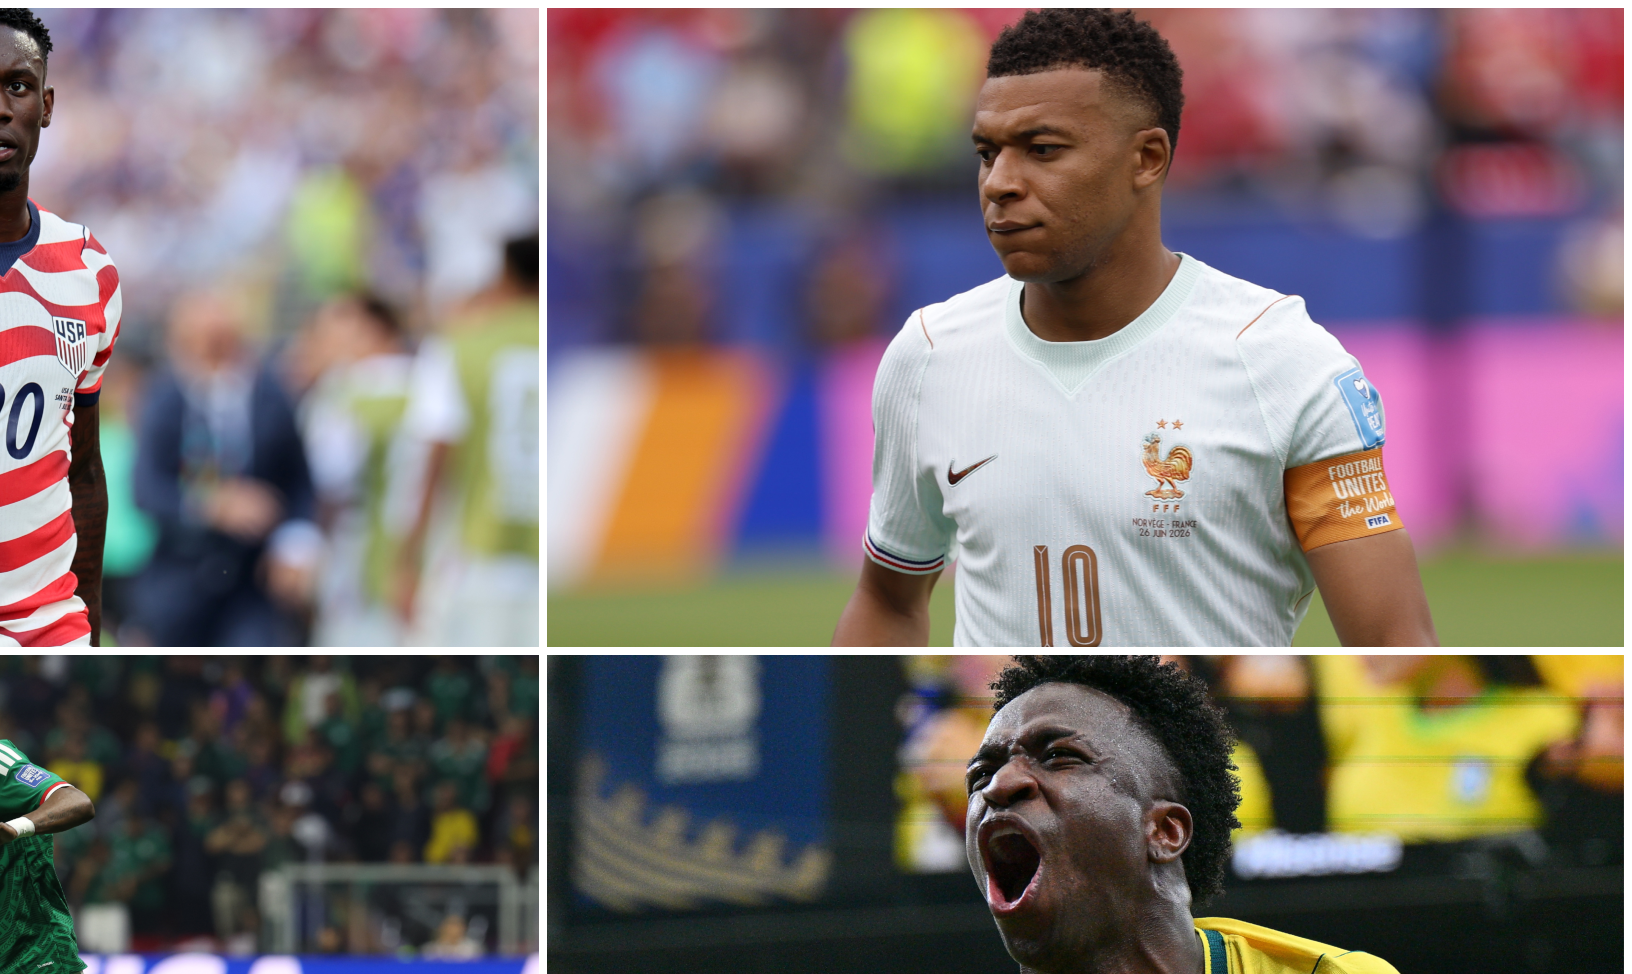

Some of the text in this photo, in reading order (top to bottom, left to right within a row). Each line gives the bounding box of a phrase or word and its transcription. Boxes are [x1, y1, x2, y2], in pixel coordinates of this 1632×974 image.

[56, 320, 86, 344] USA
[1332, 472, 1386, 500] UNITES
[1336, 501, 1364, 518] the
[1132, 516, 1166, 528] NORVÈGE
[1172, 519, 1197, 529] FRANCE
[1368, 516, 1389, 527] FIFA
[1139, 528, 1190, 538] 26 JUIN 2026
[1034, 544, 1102, 647] 10
